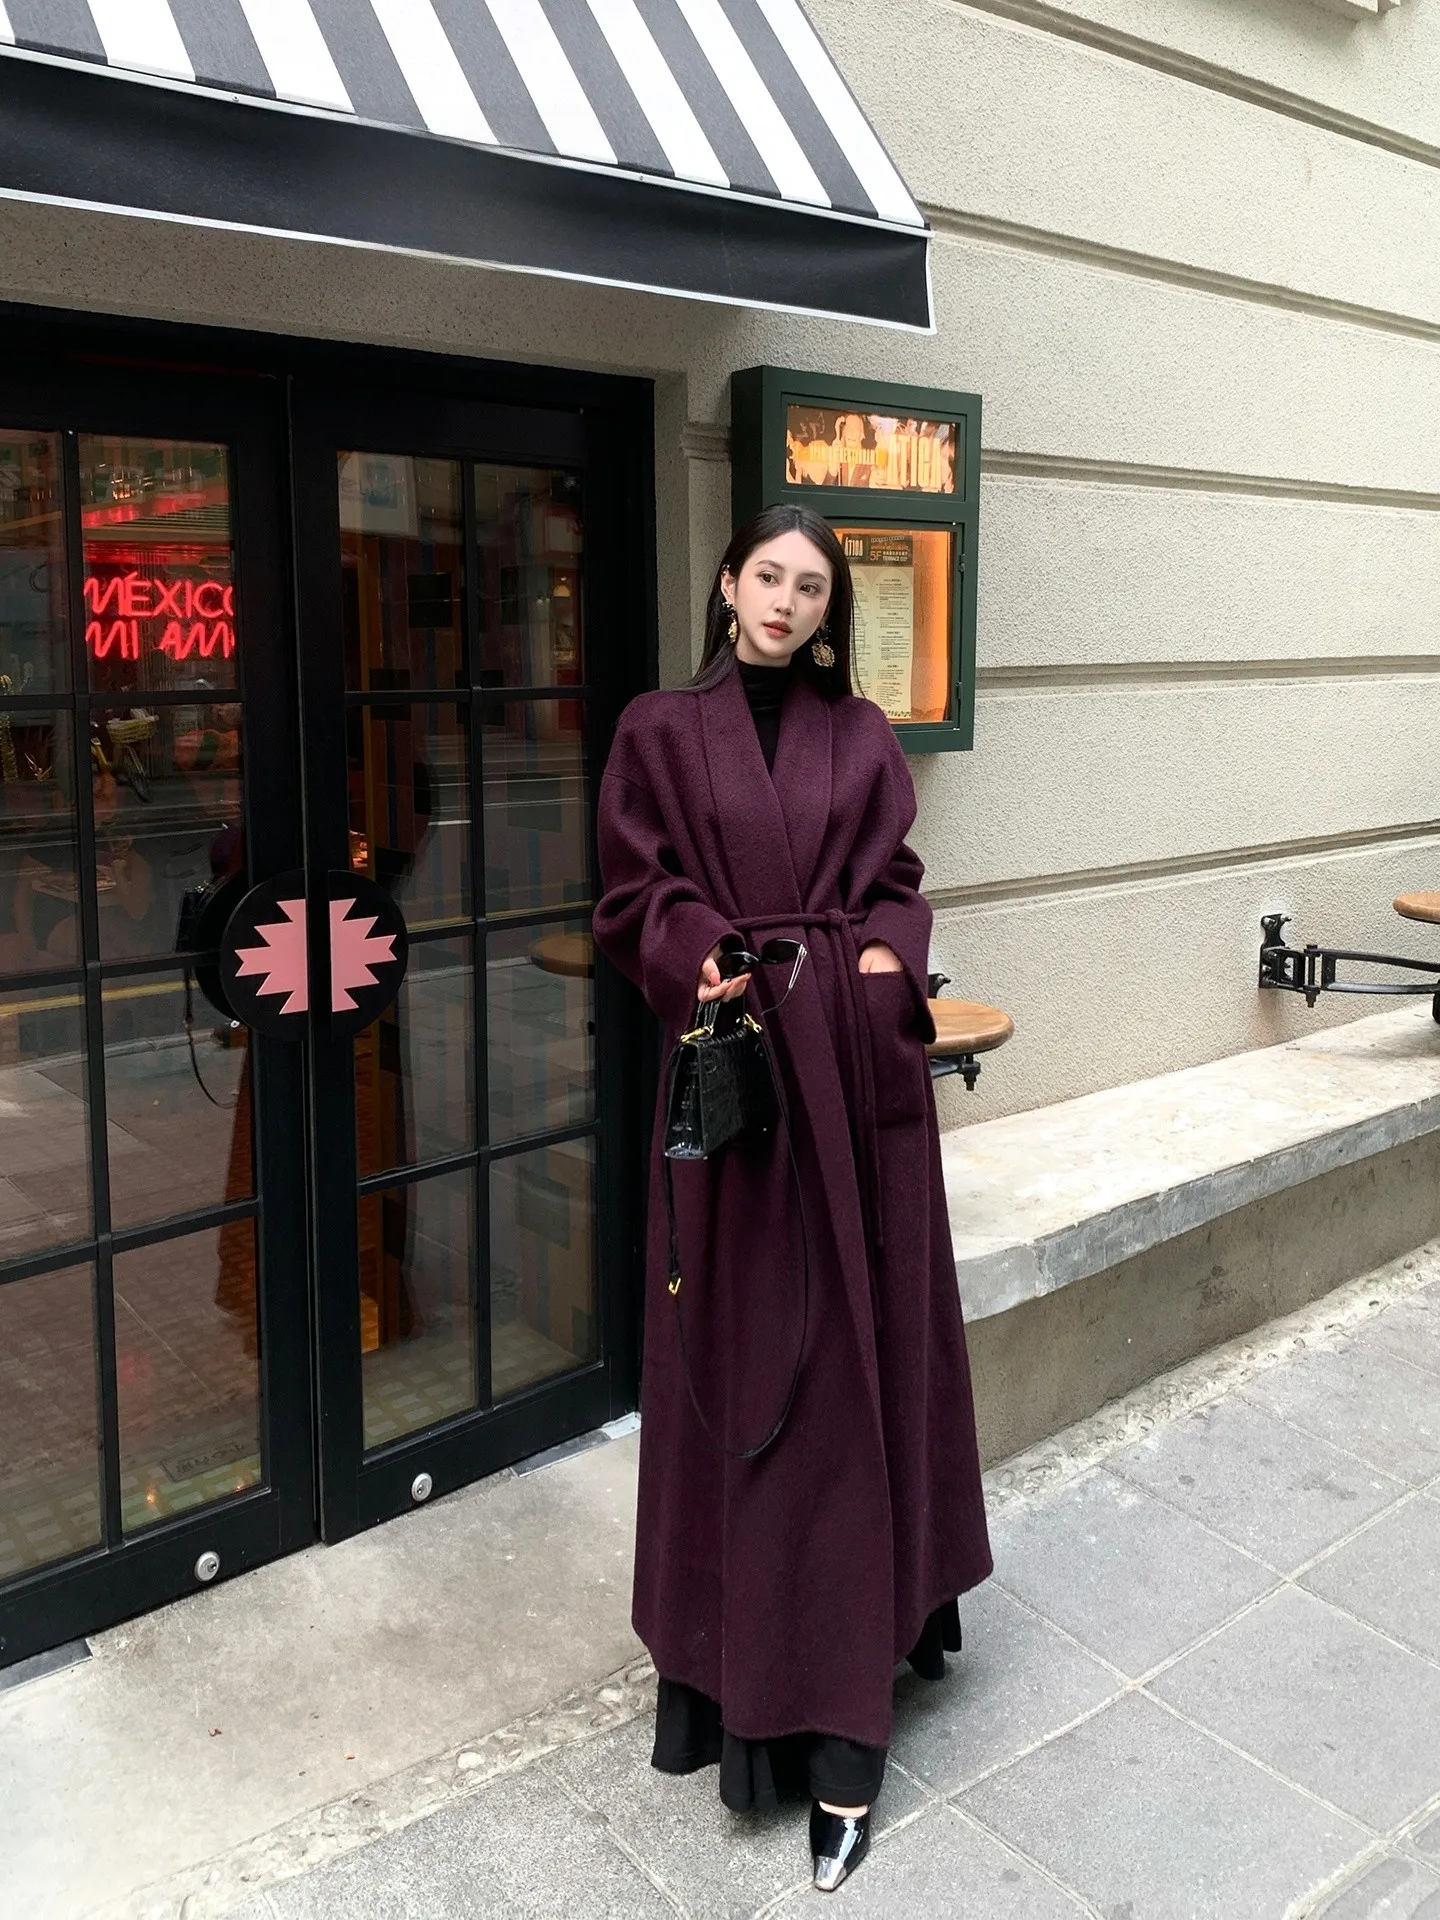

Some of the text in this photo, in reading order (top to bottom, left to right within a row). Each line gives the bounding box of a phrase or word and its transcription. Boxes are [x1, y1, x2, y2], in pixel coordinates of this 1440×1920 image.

[870, 550, 882, 561] 5F
[85, 620, 234, 660] MI AM
